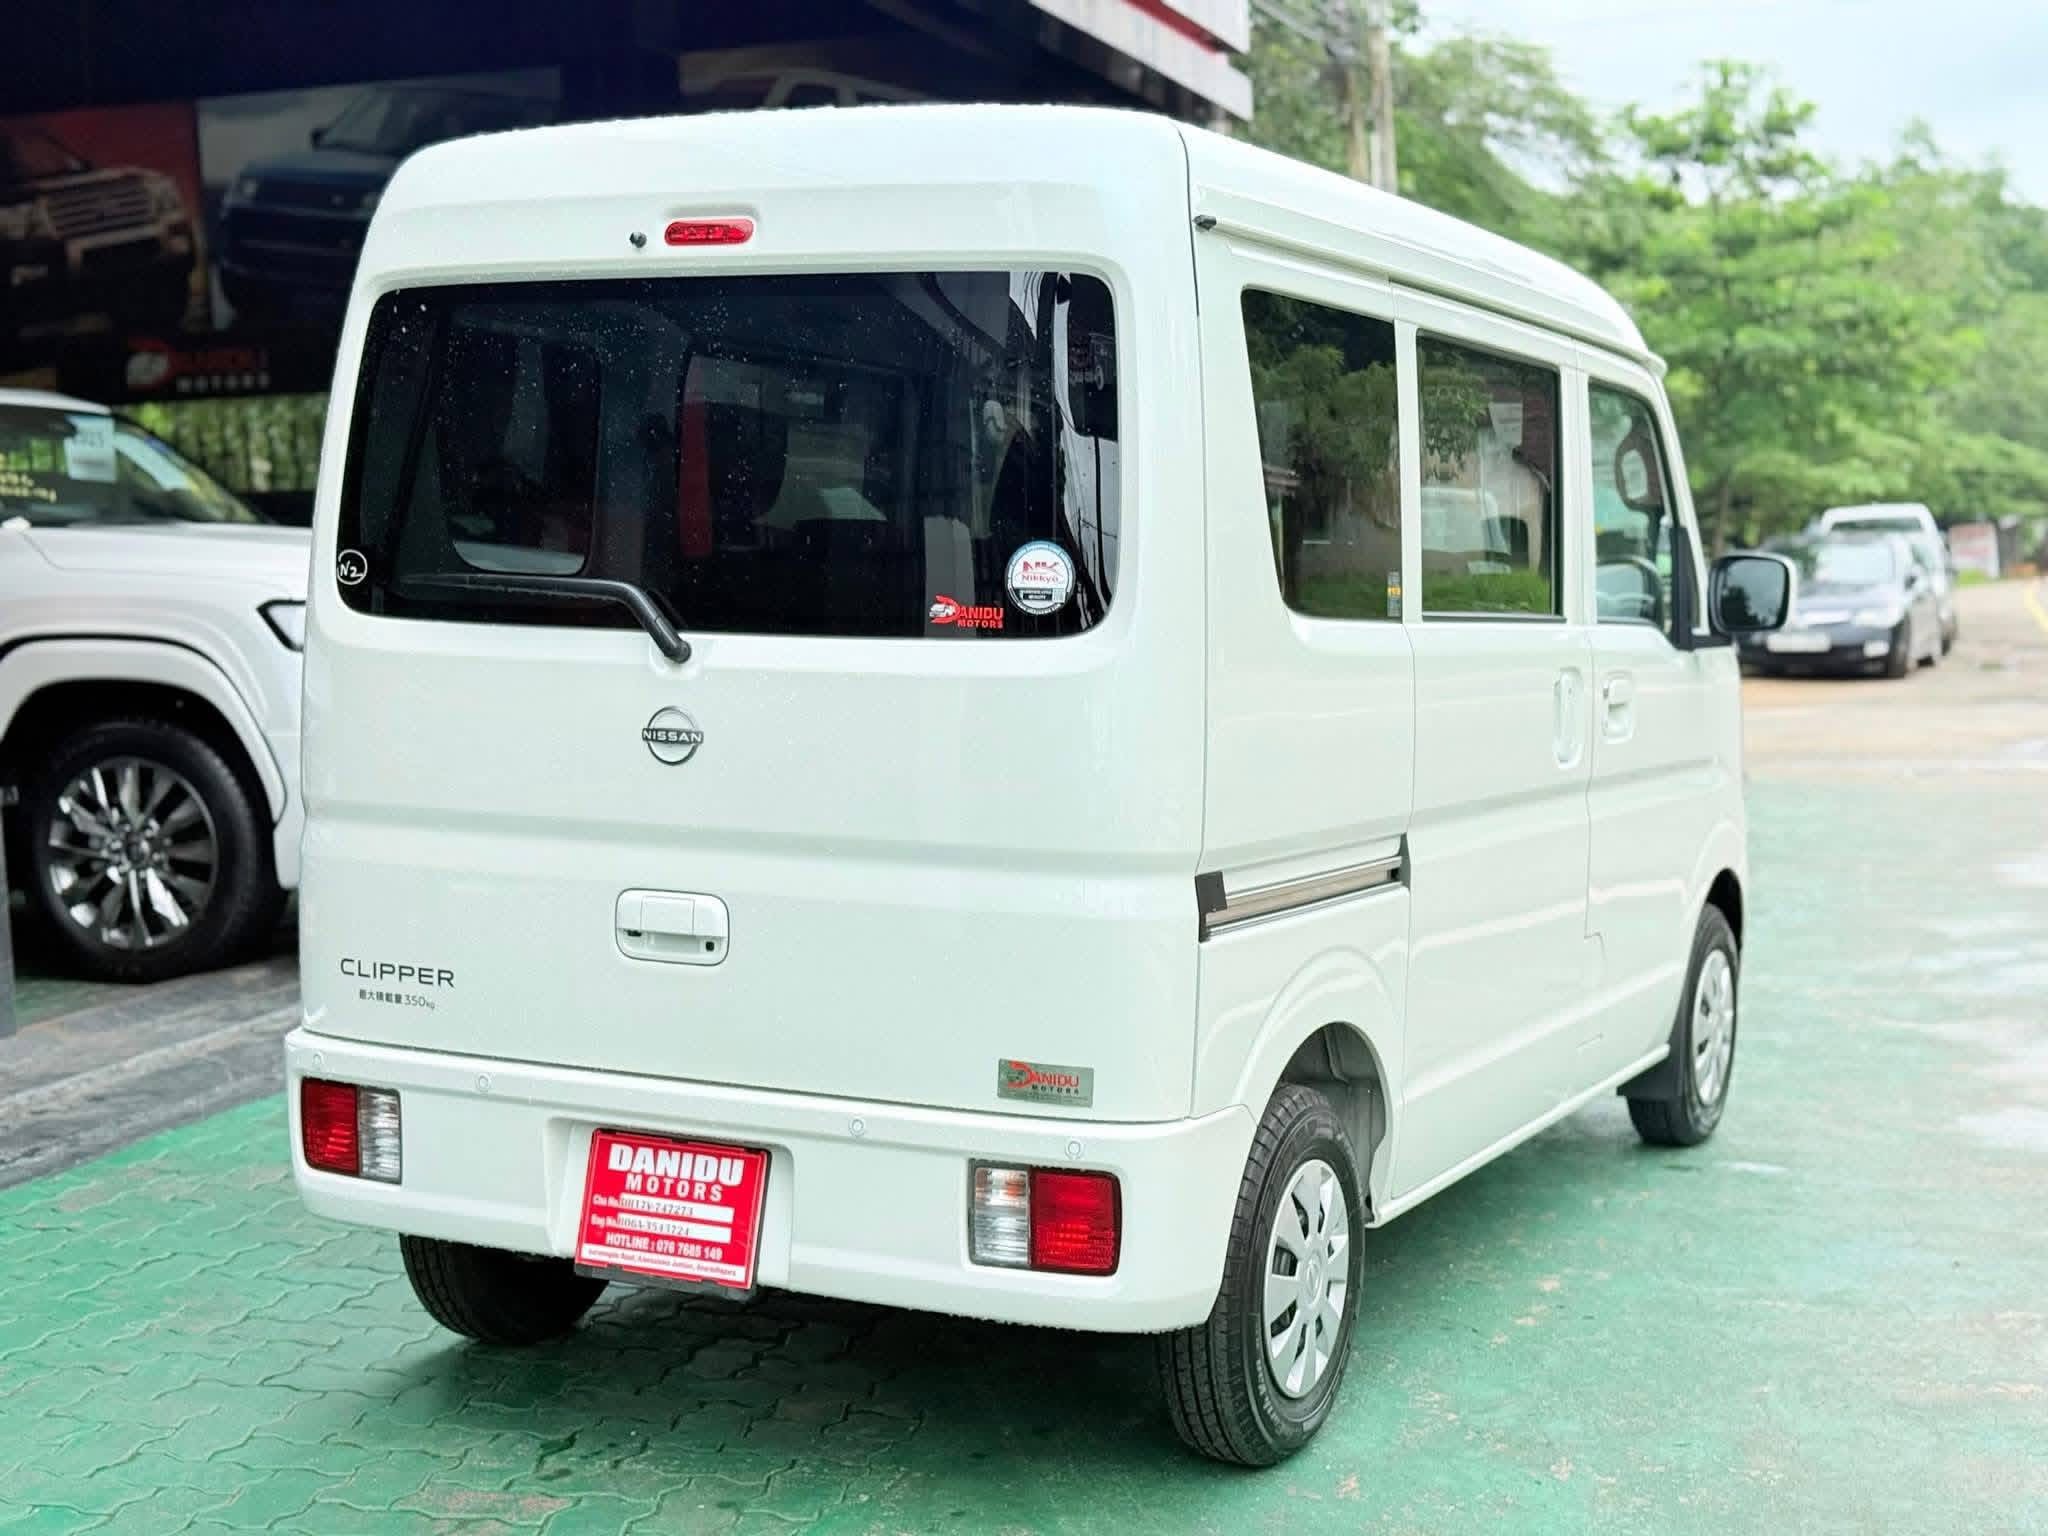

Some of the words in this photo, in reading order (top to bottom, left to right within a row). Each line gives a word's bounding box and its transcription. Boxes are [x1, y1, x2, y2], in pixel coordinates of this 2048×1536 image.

[340, 560, 364, 578] N2
[957, 618, 1004, 629] MOTORS
[643, 730, 702, 742] NISSAN
[340, 957, 455, 988] CLIPPER
[1031, 1083, 1080, 1096] MOTORS
[608, 1143, 745, 1186] DANIDU
[626, 1174, 723, 1202] MOTORS
[606, 1232, 650, 1251] HOTLINE
